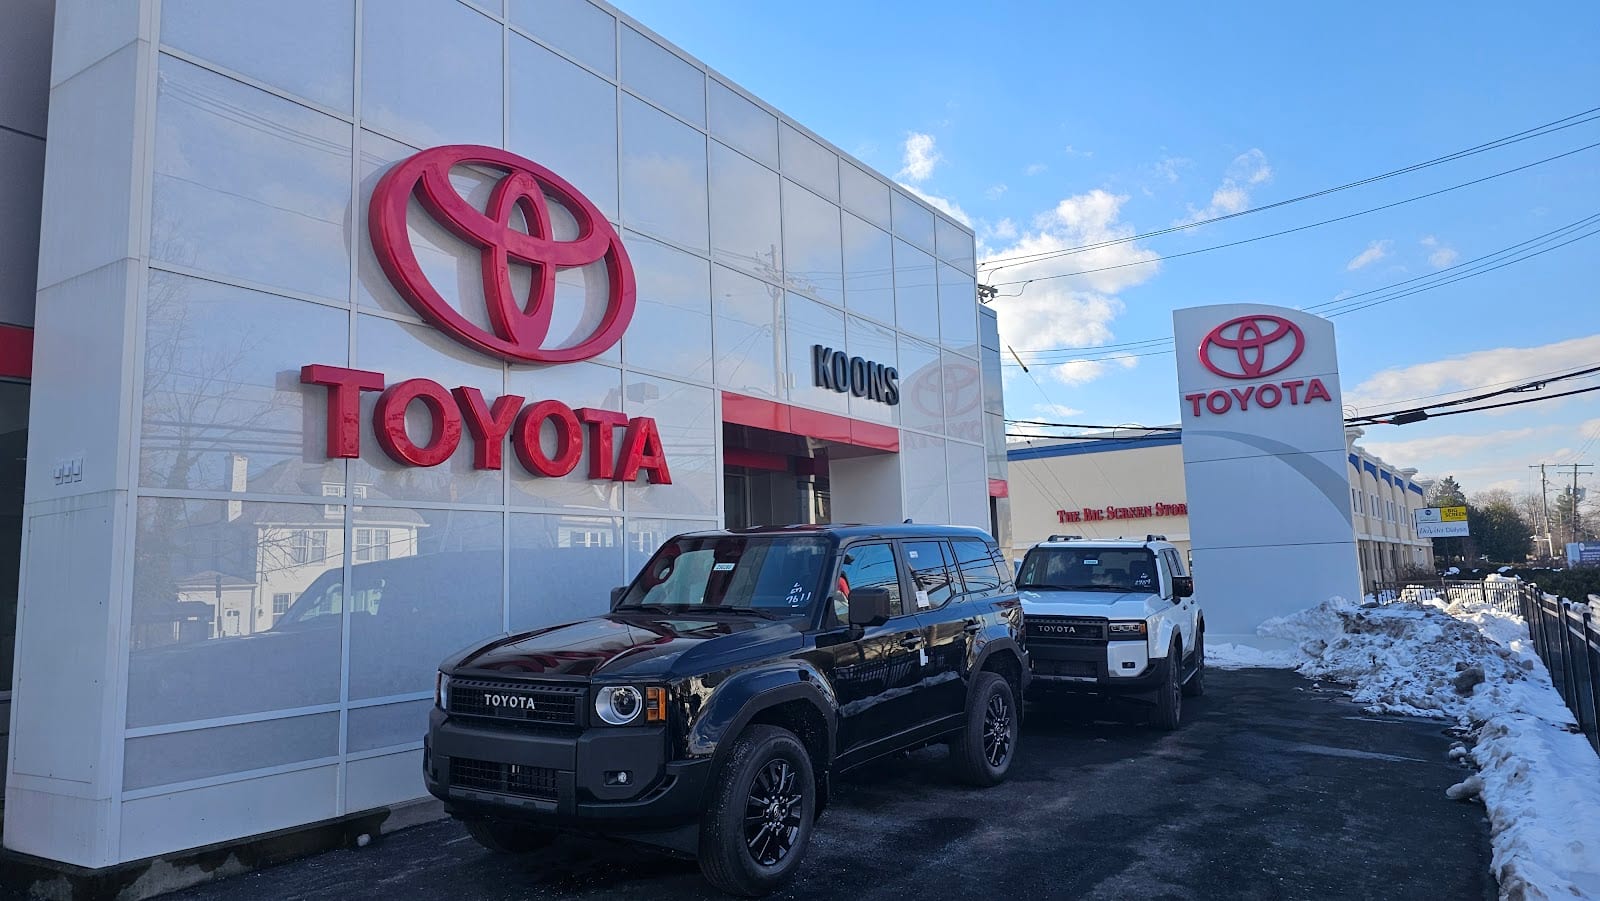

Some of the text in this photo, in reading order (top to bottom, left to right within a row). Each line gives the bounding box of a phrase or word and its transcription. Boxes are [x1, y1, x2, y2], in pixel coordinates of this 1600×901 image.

[813, 344, 899, 406] KOONS
[1185, 378, 1332, 417] TOYOTA
[301, 363, 673, 485] TOYOTA
[1056, 509, 1081, 523] THE
[1083, 507, 1104, 522] BIG
[1155, 502, 1188, 517] STOR
[1038, 625, 1076, 634] TOYOTA
[484, 693, 536, 710] TOYOTA
